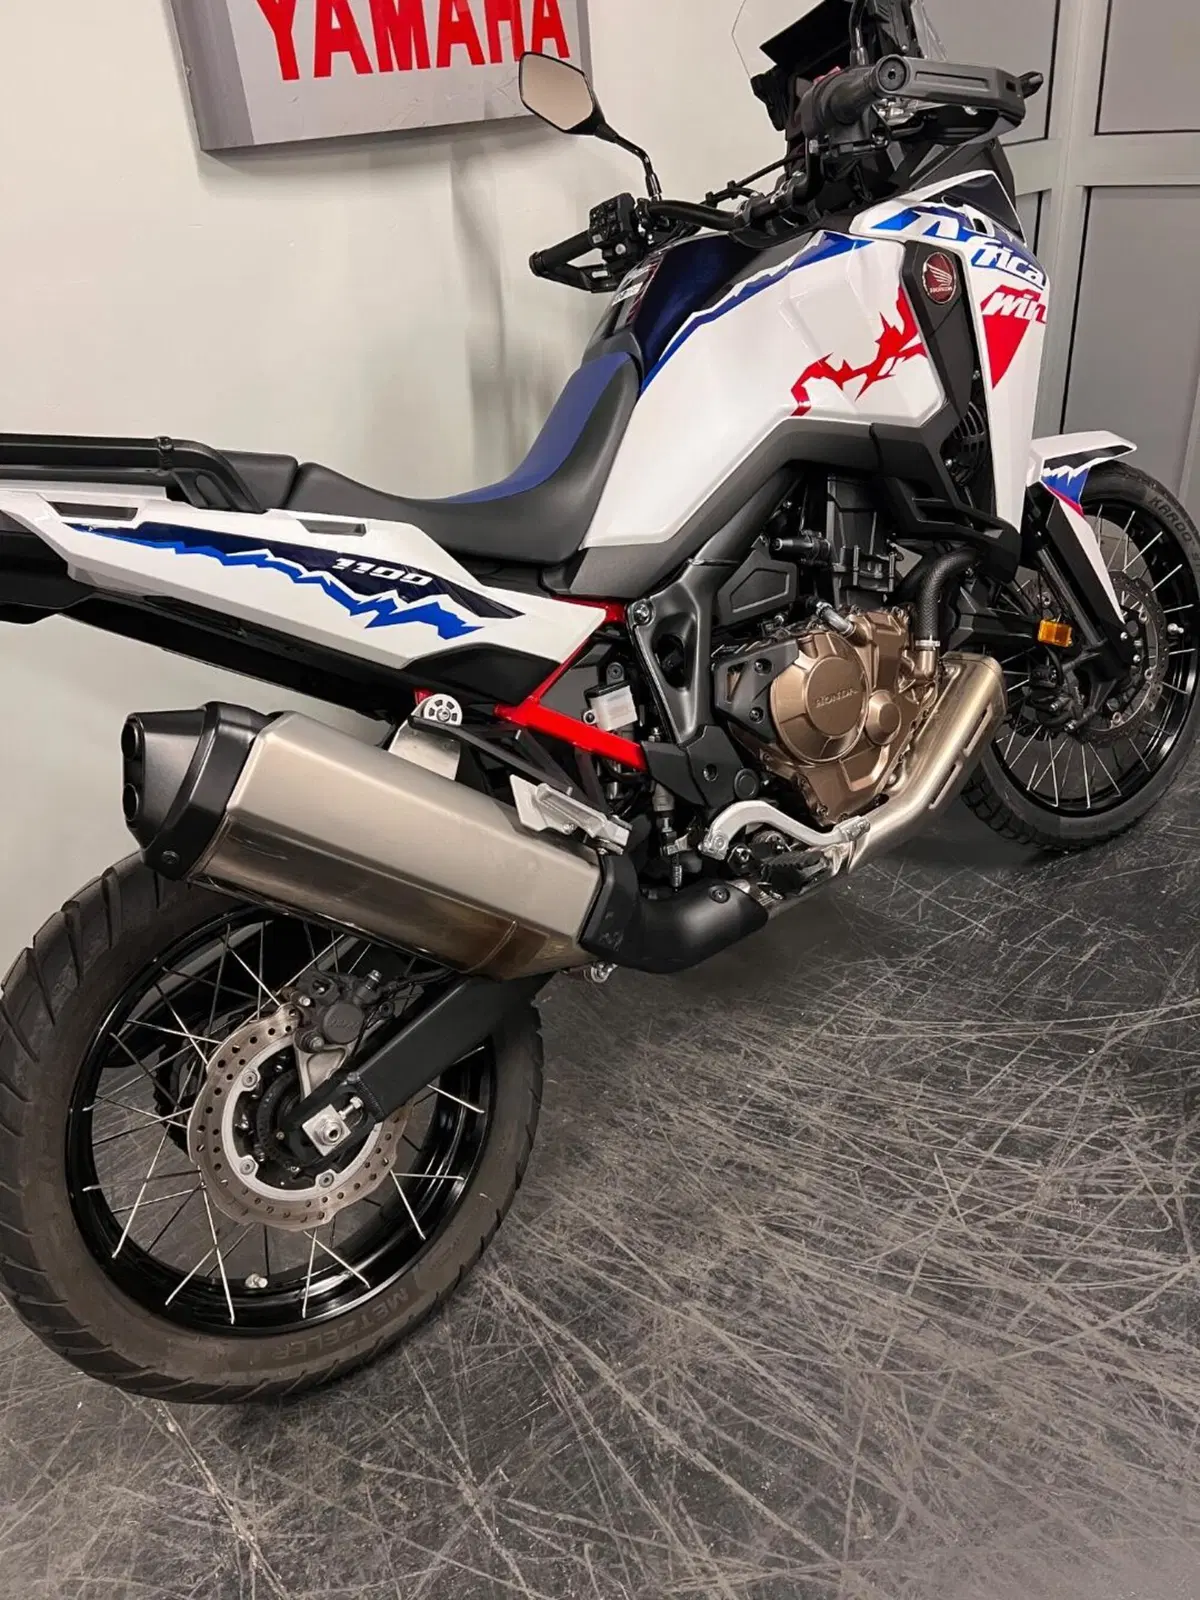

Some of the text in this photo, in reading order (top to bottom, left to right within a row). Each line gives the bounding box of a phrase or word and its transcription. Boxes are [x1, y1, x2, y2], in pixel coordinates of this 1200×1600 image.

[258, 0, 570, 81] YAMAHA
[1148, 496, 1193, 542] KAROO
[332, 558, 433, 586] 1100
[815, 687, 859, 708] HONDA
[272, 1287, 409, 1360] METZELER
